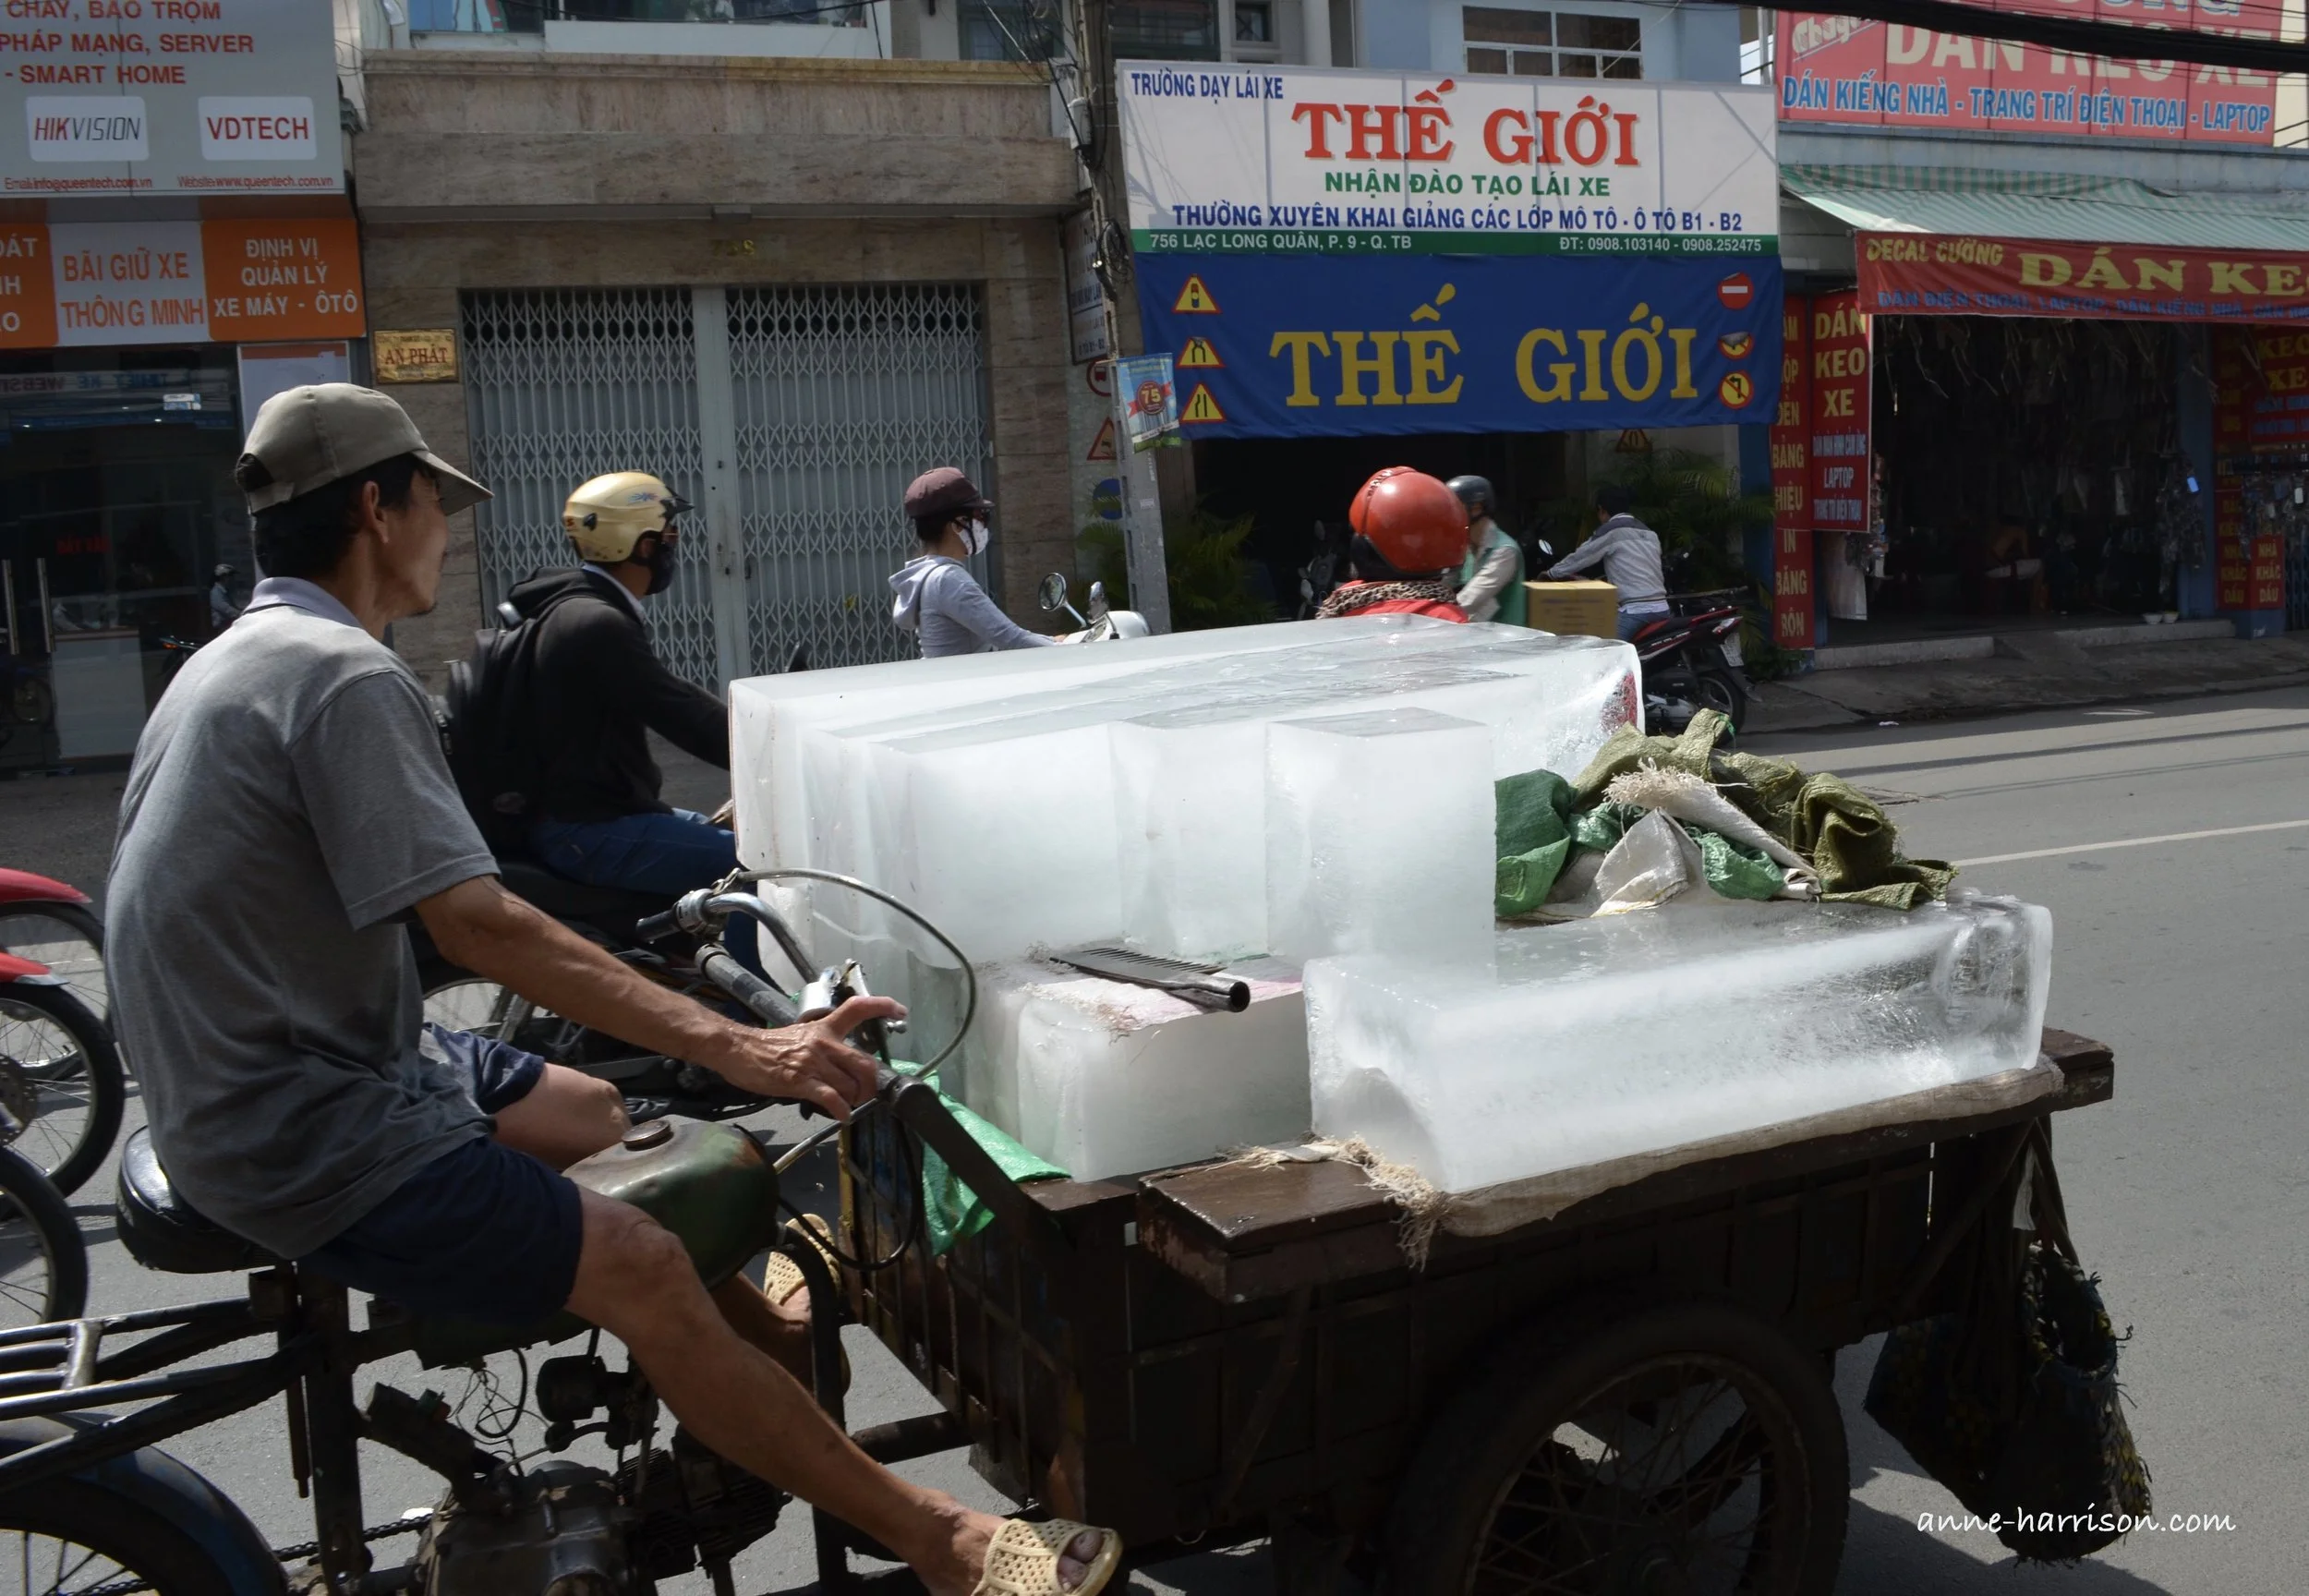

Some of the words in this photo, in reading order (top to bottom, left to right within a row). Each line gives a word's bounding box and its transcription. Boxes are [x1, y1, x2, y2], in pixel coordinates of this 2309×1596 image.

[72, 34, 151, 56] MẠNG,
[160, 34, 254, 53] SERVER
[20, 66, 105, 83] SMART
[117, 66, 187, 84] HOME
[1131, 68, 1195, 97] TRƯỜNG
[1201, 75, 1229, 104] DẠY
[1236, 70, 1259, 99] LÁI
[1264, 77, 1283, 99] XE
[1783, 68, 1829, 110] DÁN
[1835, 69, 1901, 114] KIẾNG
[1906, 77, 1949, 116] NHÀ
[1969, 87, 2036, 120] TRANG
[2041, 85, 2076, 123] TRÍ
[2078, 88, 2124, 131] ĐIỆN
[2130, 97, 2186, 134] THOẠI
[2202, 101, 2271, 133] LAPTOP
[34, 116, 140, 140] HIKVISION
[207, 116, 308, 139] VDTECH
[1291, 79, 1456, 163] THẾ
[1483, 95, 1640, 167] GIỚI
[1325, 168, 1400, 199] NHẬN
[1409, 168, 1463, 195] ĐÀO
[1471, 175, 1522, 200] TẠO
[1531, 171, 1569, 196] LÁI
[1579, 177, 1610, 197] XE
[1173, 200, 1263, 227] THƯỜNG
[1269, 201, 1339, 228] XUYÊN
[1347, 207, 1396, 228] KHAI
[1403, 200, 1465, 229] GIẢNG
[1470, 203, 1513, 229] CÁC
[1517, 203, 1553, 229] LỚP
[1559, 206, 1587, 230] MÔ
[1593, 206, 1616, 230] TÔ
[1634, 207, 1646, 230] Ô
[1652, 207, 1675, 230] TÔ
[1682, 212, 1702, 231] B1
[1721, 212, 1742, 231] B2
[0, 233, 38, 258] ÁT
[246, 238, 294, 261] ĐỊNH
[299, 237, 319, 260] VỊ
[1150, 234, 1178, 248] 756
[1183, 234, 1216, 250] LẠC
[1222, 234, 1267, 248] LONG
[1273, 231, 1324, 250] QUÂN,
[1328, 235, 1344, 248] P.
[1348, 235, 1357, 248] 9
[1371, 235, 1386, 248] Q.
[1393, 236, 1412, 248] TB
[1559, 237, 1584, 250] ĐT:
[1588, 237, 1670, 250] 0908.103140
[1682, 238, 1761, 252] 0908.252475
[1867, 237, 1930, 262] DECAL
[63, 250, 103, 281] BÃI
[111, 247, 151, 282] GIỮ
[157, 252, 189, 279] XE
[241, 260, 298, 286] QUẢN
[304, 260, 328, 284] LÝ
[2018, 246, 2187, 292] DÁN
[2206, 261, 2309, 296] KE
[61, 295, 144, 328] THÔNG
[151, 298, 203, 325] MINH
[214, 297, 241, 318] XE
[246, 292, 288, 316] MÁY
[315, 289, 358, 314] ÔTÔ
[1783, 310, 1799, 342] ÀM
[1814, 301, 1868, 341] DÁN
[385, 347, 405, 365] AN
[1269, 283, 1465, 406] THẾ
[1516, 302, 1698, 403] GIỚI
[1815, 346, 1866, 379] KEO
[1141, 389, 1161, 405] 75
[1823, 388, 1856, 417] XE
[1772, 434, 1805, 469] BẢNG
[1824, 466, 1855, 489] LAPTOP
[1775, 480, 1804, 519] HIỆU
[1783, 529, 1797, 553] IN
[1775, 565, 1807, 596] BĂNG
